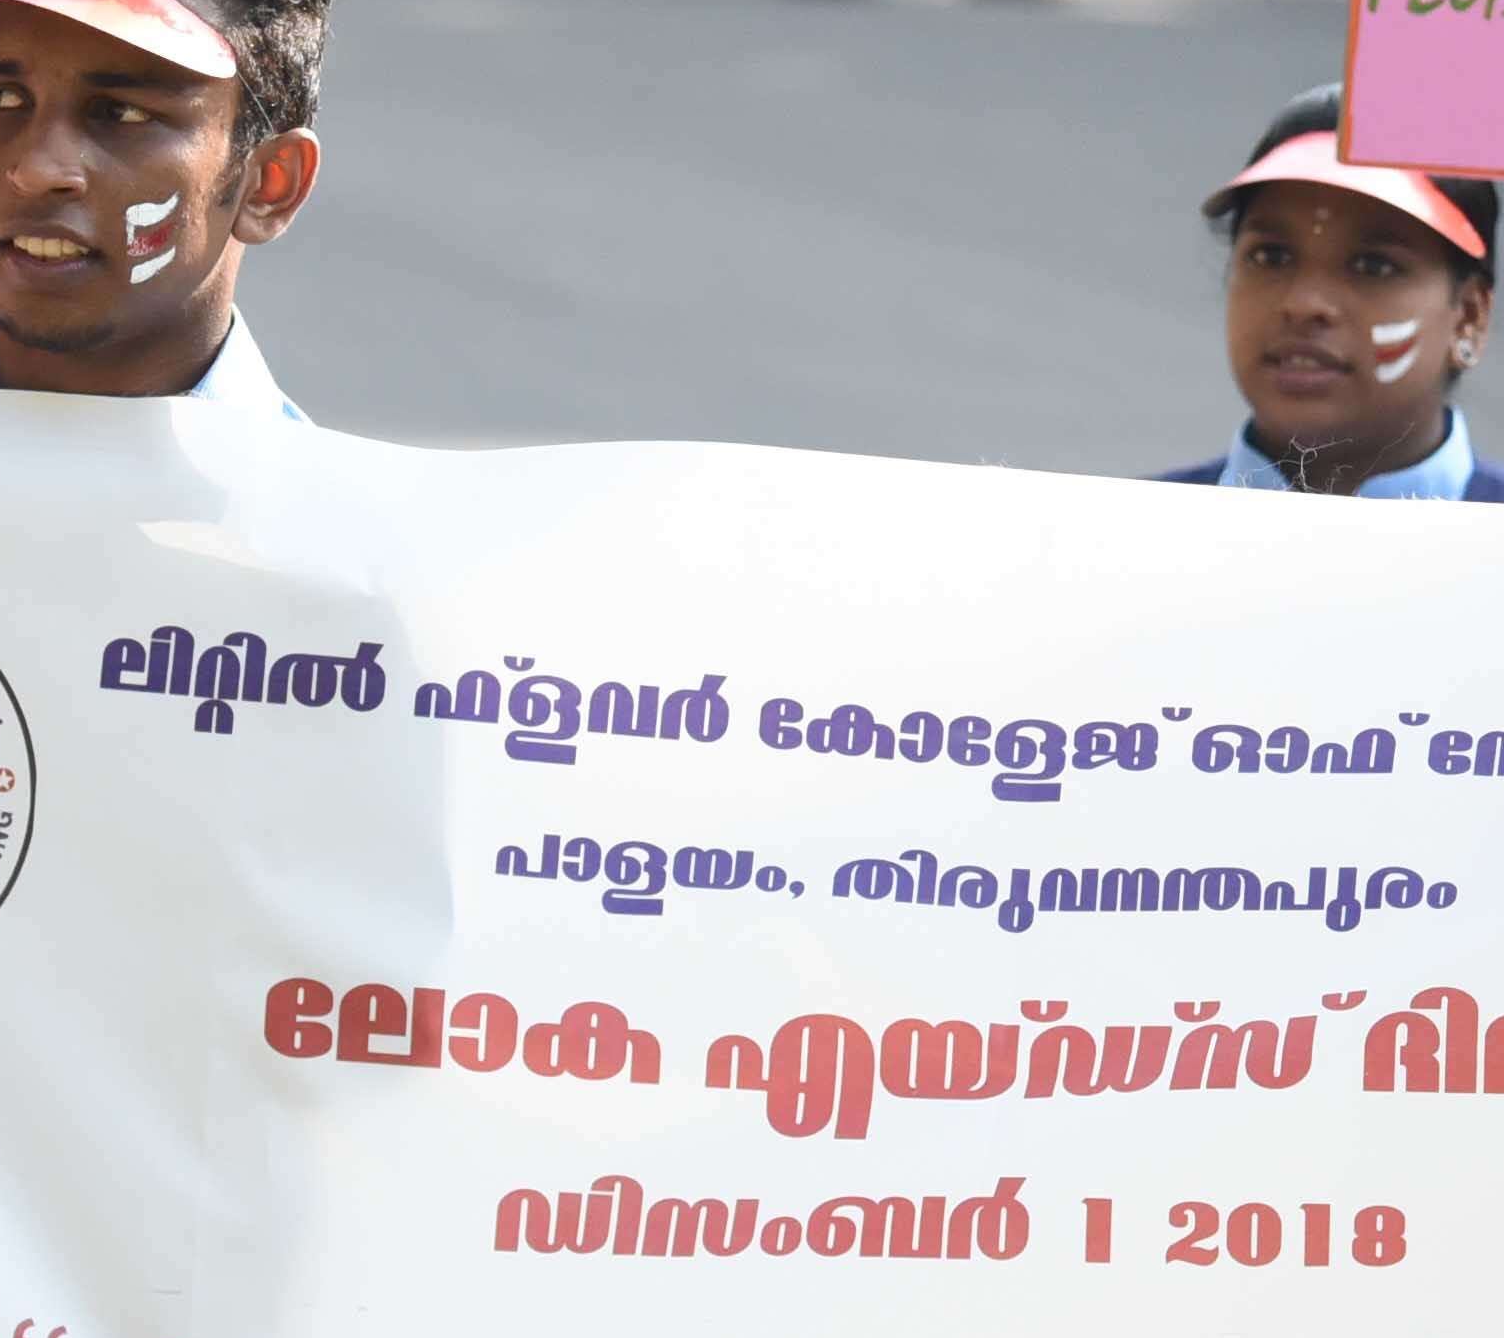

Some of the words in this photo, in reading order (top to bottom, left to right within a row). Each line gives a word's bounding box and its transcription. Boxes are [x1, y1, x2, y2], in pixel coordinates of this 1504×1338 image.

[99, 625, 385, 736] ലിറ്റിൽ
[1190, 711, 1432, 775] ഓഫ്
[831, 849, 1458, 935] തിരുവനന്തപുരം
[263, 976, 662, 1085] ലോക
[494, 1174, 1030, 1261] ഡിസംബർ
[1085, 1197, 1112, 1264] 1
[1165, 1201, 1408, 1268] 2018
